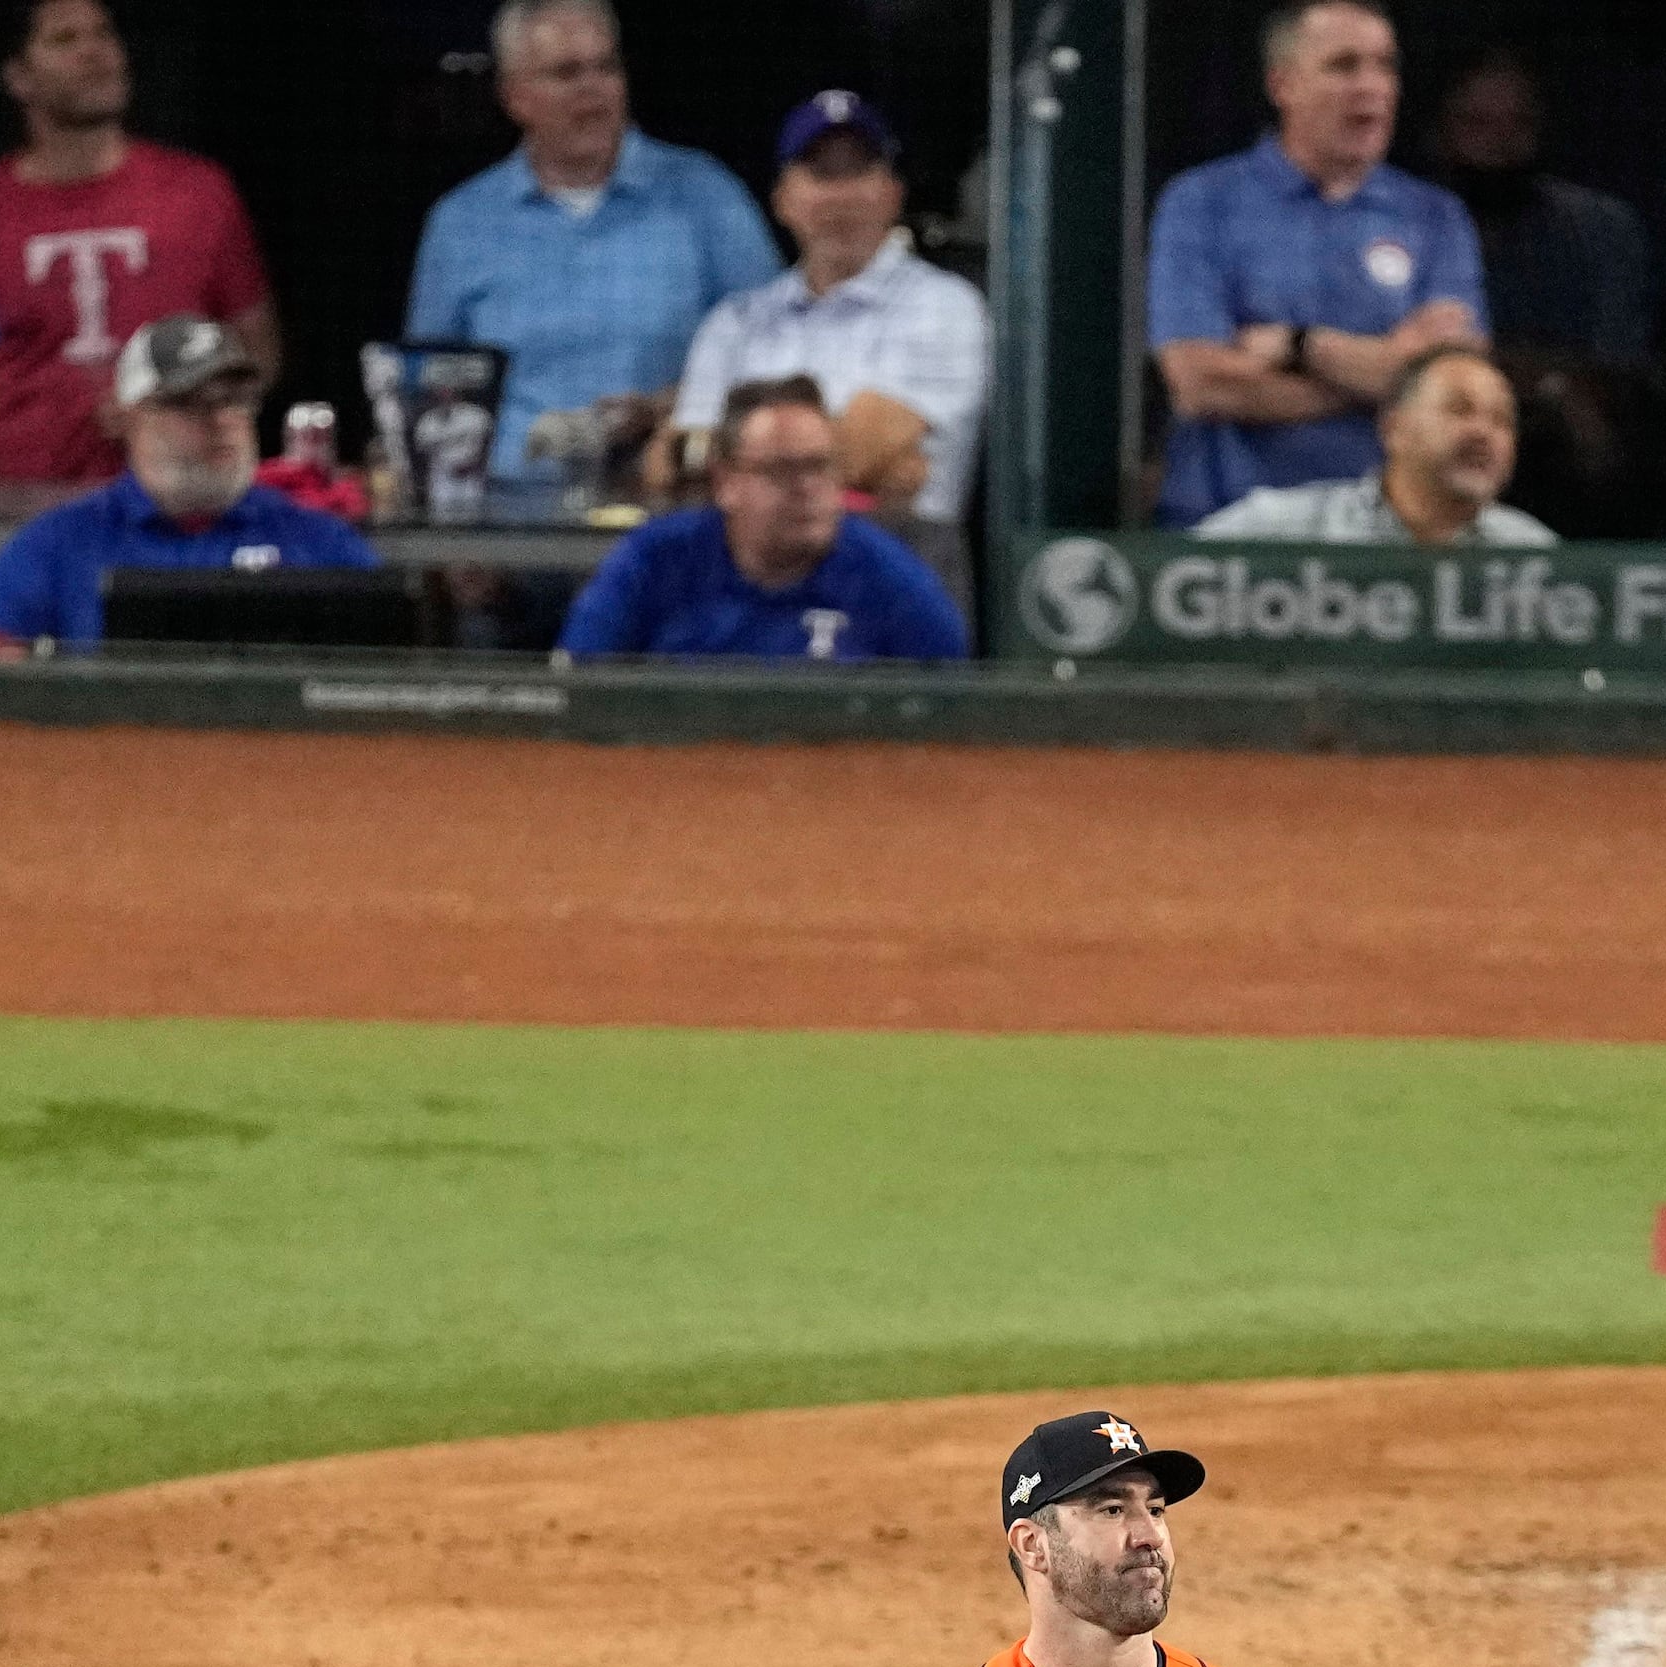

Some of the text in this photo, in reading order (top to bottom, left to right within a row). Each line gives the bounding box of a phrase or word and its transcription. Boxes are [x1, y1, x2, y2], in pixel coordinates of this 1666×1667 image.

[24, 227, 148, 364] T
[1151, 556, 1416, 640] Globe
[1435, 556, 1597, 642] Life
[1100, 1423, 1140, 1450] H
